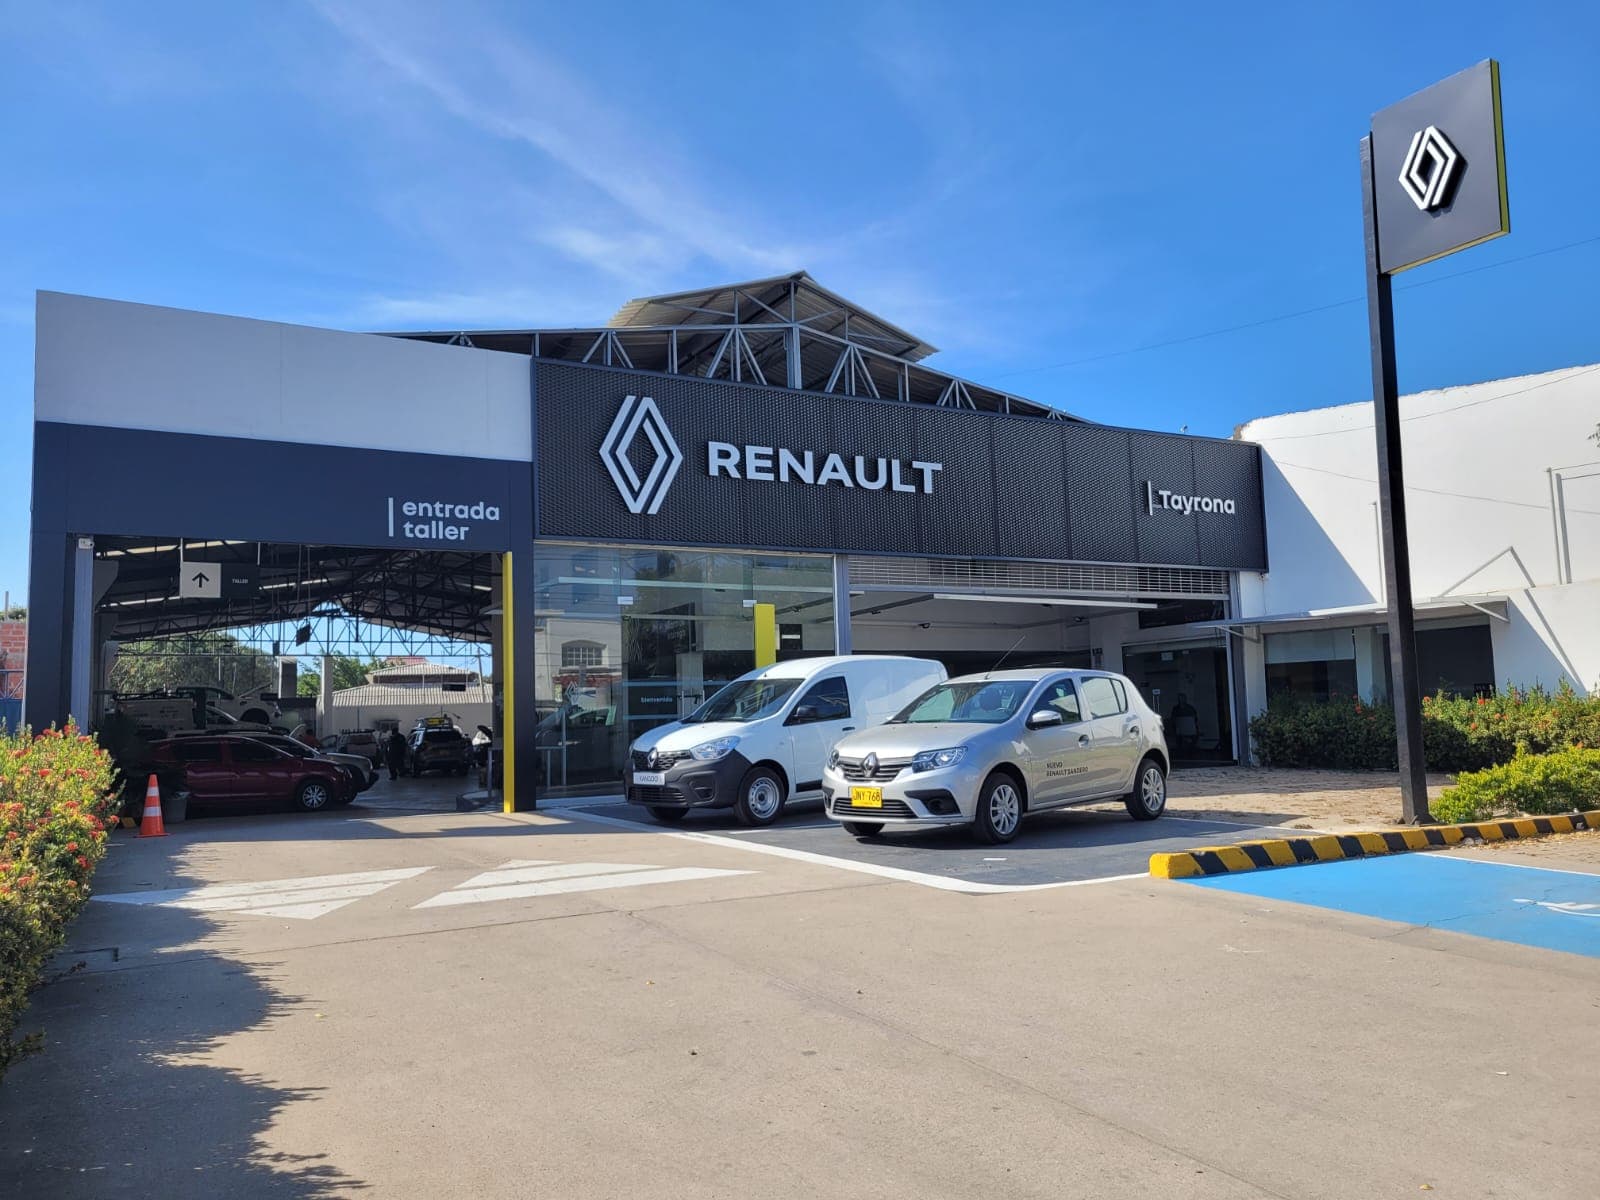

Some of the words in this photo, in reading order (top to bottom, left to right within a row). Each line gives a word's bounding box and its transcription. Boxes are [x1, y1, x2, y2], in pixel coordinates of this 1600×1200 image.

[707, 441, 943, 494] RENAULT
[402, 499, 500, 522] entrada
[1158, 489, 1236, 515] Tayrona
[403, 520, 470, 541] taller
